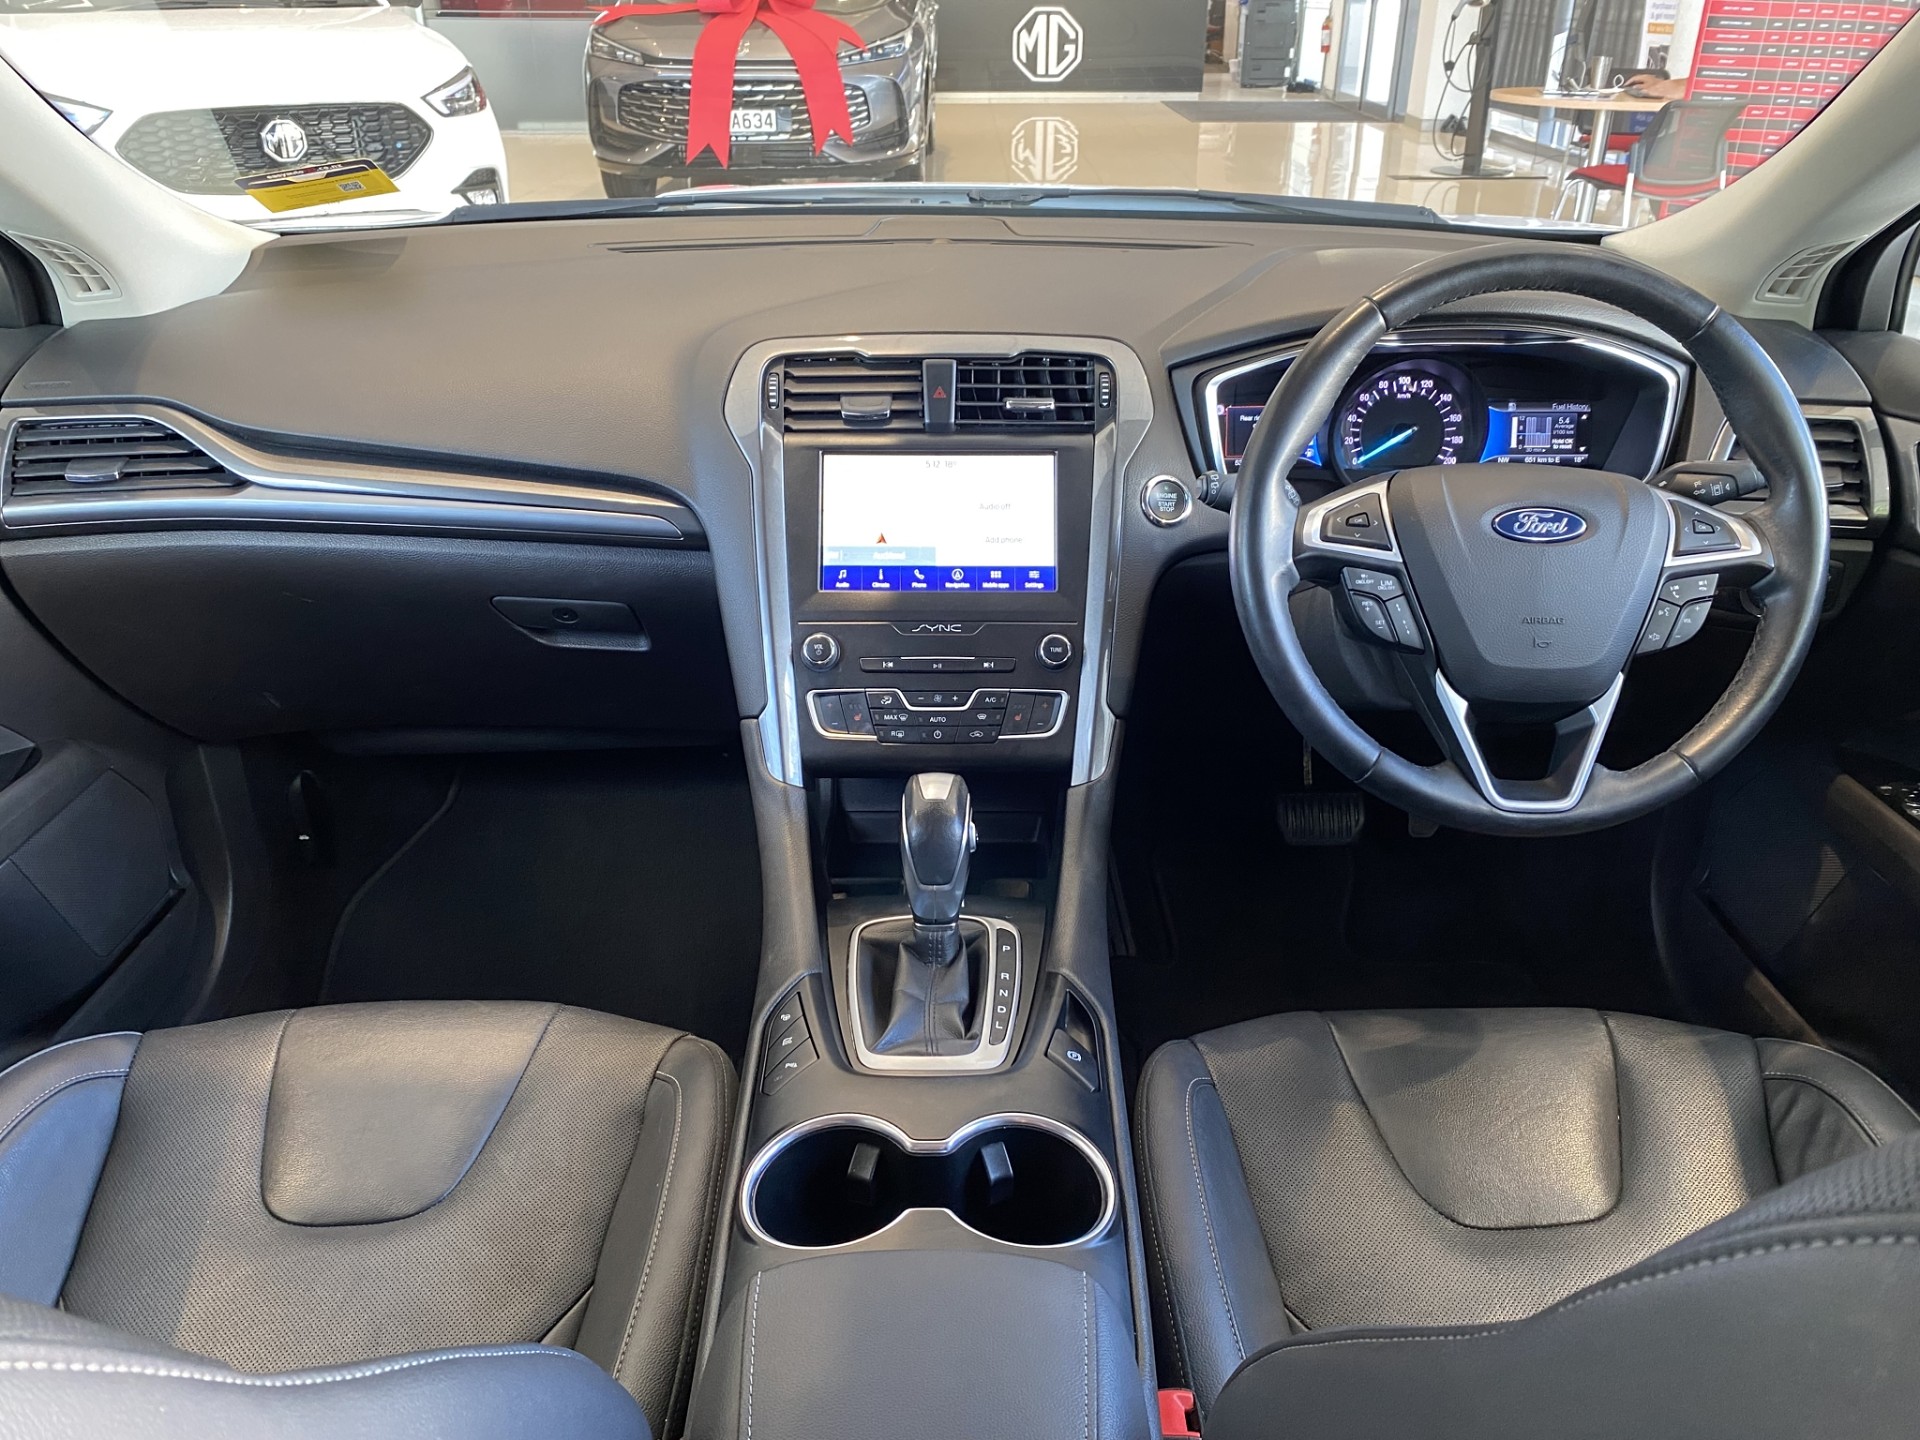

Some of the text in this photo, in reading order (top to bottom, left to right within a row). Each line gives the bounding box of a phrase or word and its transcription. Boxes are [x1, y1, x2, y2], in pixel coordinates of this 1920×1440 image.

[1019, 14, 1076, 75] MG
[732, 112, 773, 129] A634
[265, 120, 304, 159] MG
[1420, 380, 1433, 388] 120
[1440, 394, 1452, 402] 140
[1552, 403, 1589, 412] Fuel History
[1347, 414, 1357, 422] 40
[1449, 414, 1461, 422] 160
[1344, 437, 1353, 445] 20
[1451, 436, 1463, 444] 180
[925, 460, 940, 468] 512
[1443, 456, 1456, 464] 200
[1513, 512, 1568, 534] Ford
[1522, 616, 1565, 624] AIRBAG
[912, 624, 961, 632] SYNC
[1001, 972, 1009, 980] R
[999, 989, 1008, 997] N
[997, 1005, 1006, 1013] D
[995, 1021, 1003, 1029] L
